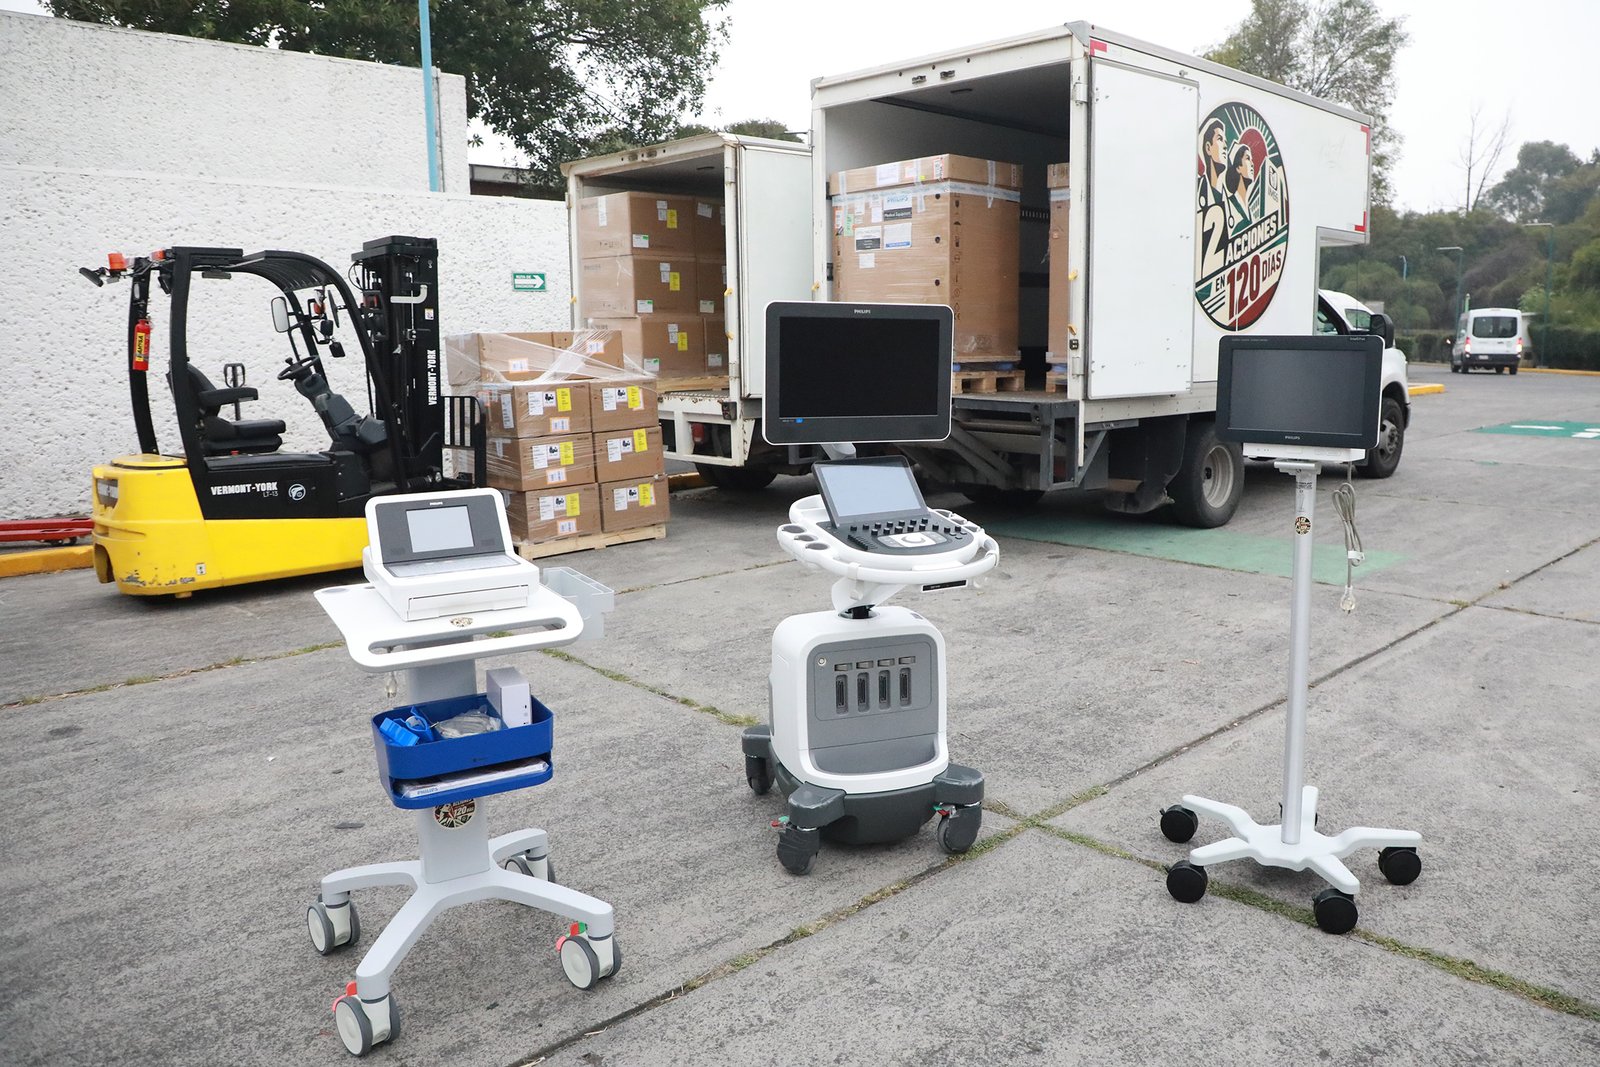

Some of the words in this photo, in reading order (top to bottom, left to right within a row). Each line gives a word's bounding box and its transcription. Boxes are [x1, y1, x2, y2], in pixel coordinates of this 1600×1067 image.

[1225, 213, 1277, 266] ACCIONES
[1215, 274, 1225, 292] EN
[1227, 254, 1261, 321] 120
[1262, 249, 1281, 282] DÍAS
[427, 349, 437, 406] VERMONT-YORK
[210, 481, 278, 496] VERMONT-YORK
